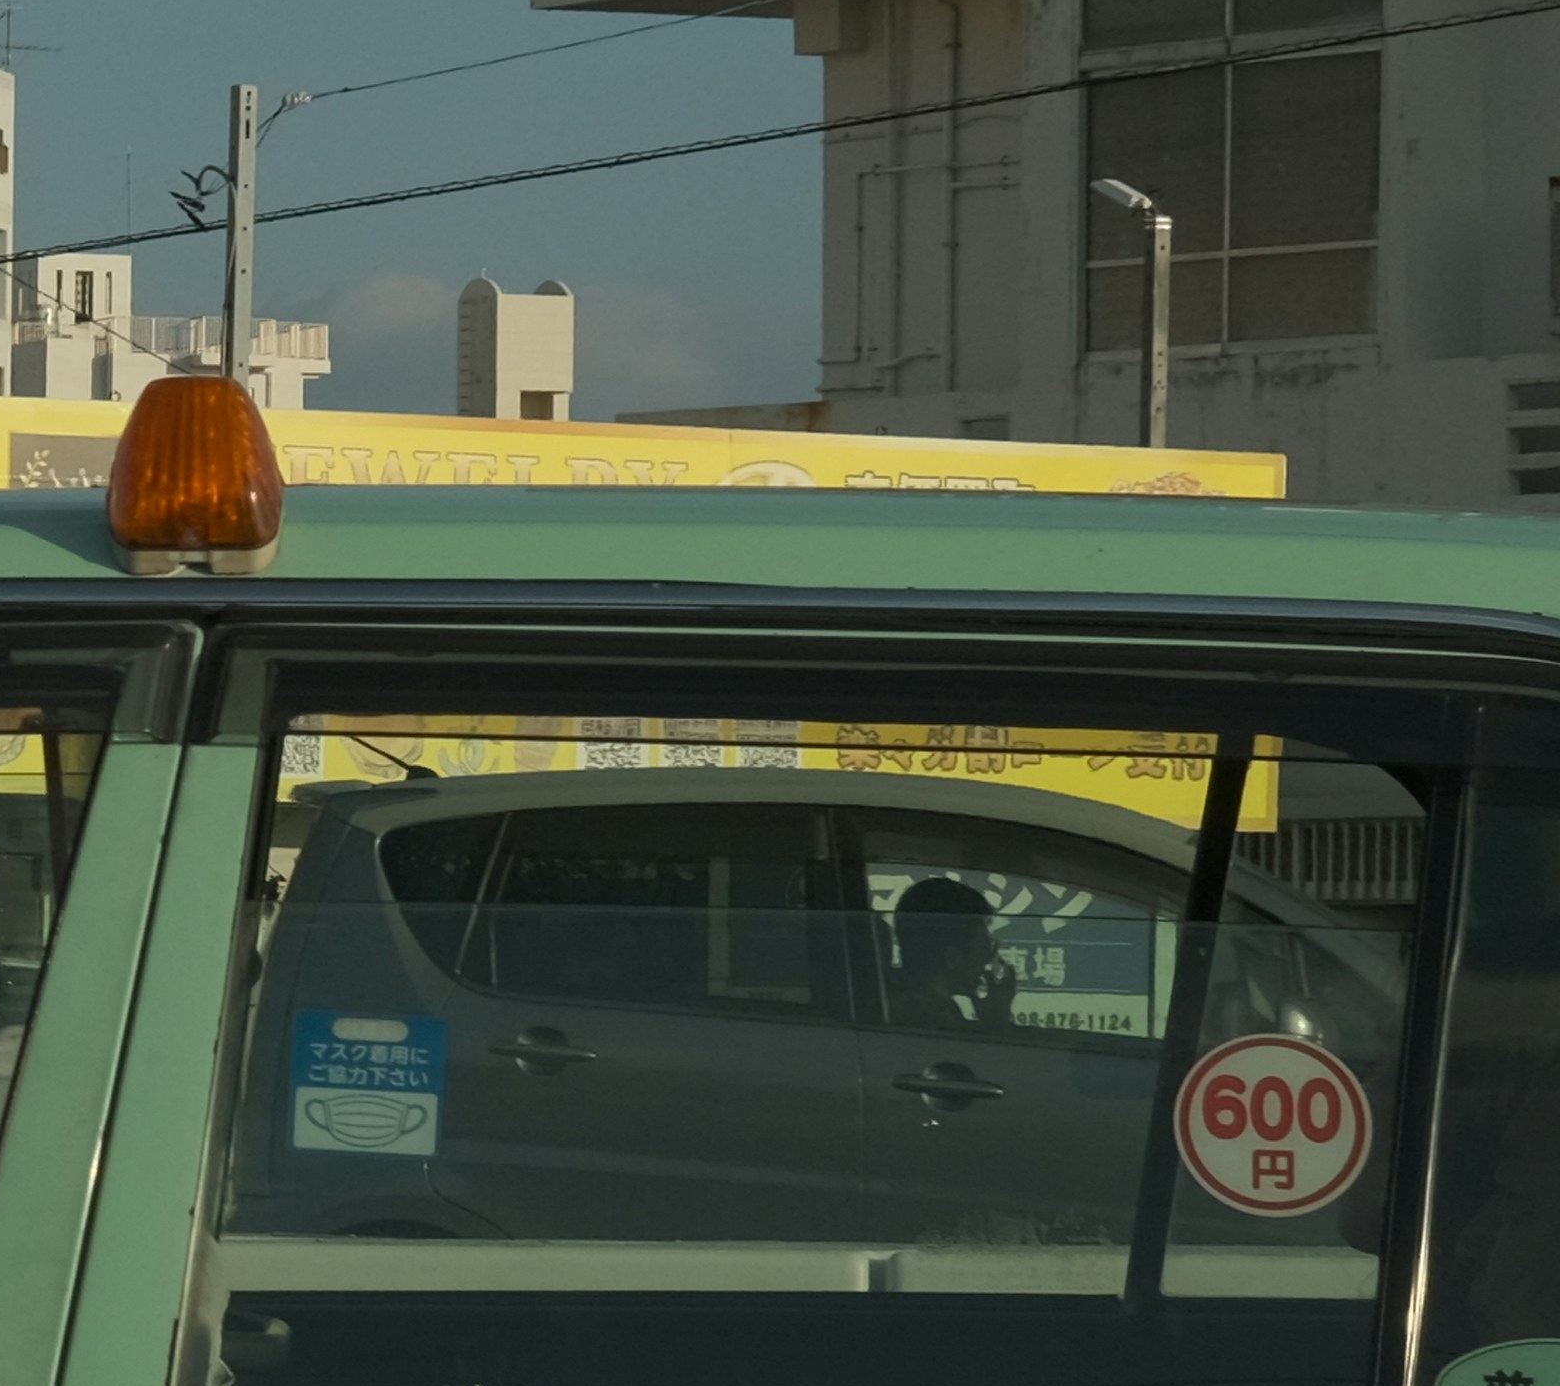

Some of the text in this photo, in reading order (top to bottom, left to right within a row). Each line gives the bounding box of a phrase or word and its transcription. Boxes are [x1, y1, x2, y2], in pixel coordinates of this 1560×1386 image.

[309, 1042, 429, 1065] マスク着用に
[308, 1064, 428, 1087] ご協力下さい
[1202, 1075, 1342, 1144] 600
[1251, 1149, 1295, 1191] 円
